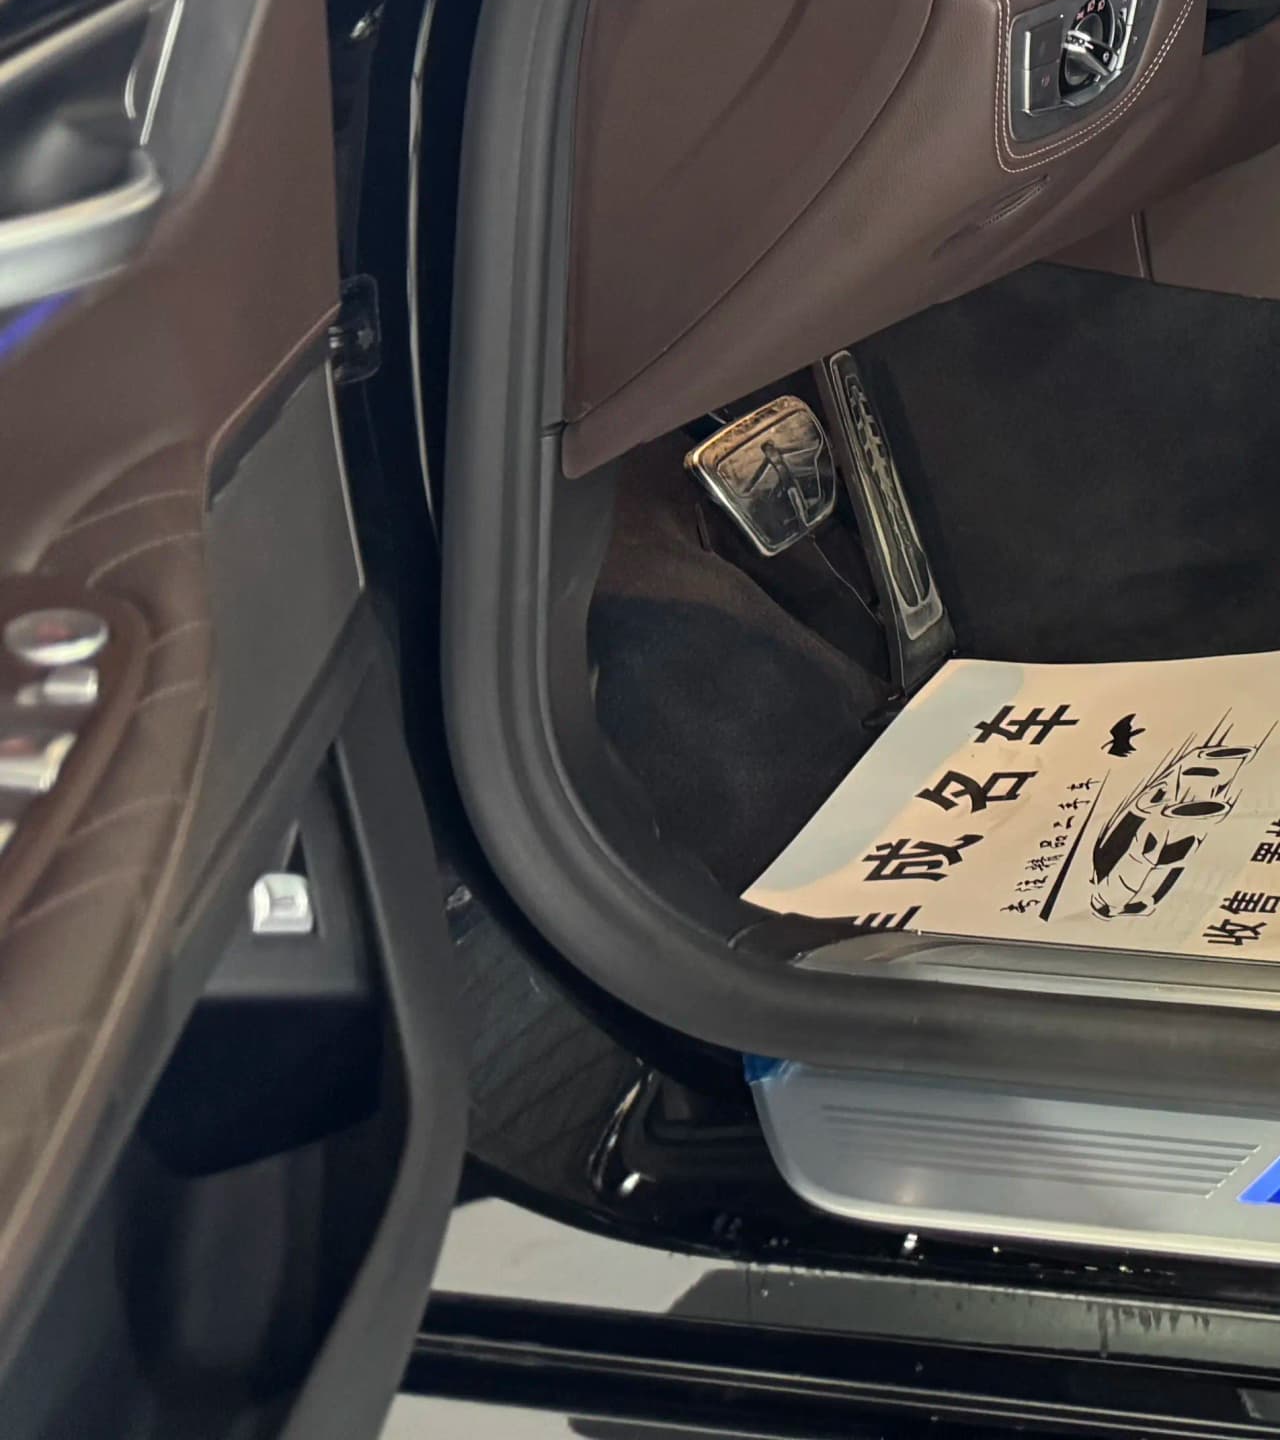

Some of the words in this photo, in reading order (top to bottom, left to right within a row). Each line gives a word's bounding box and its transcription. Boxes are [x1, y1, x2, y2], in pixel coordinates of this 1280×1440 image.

[1000, 776, 1102, 913] 专注精品二手车
